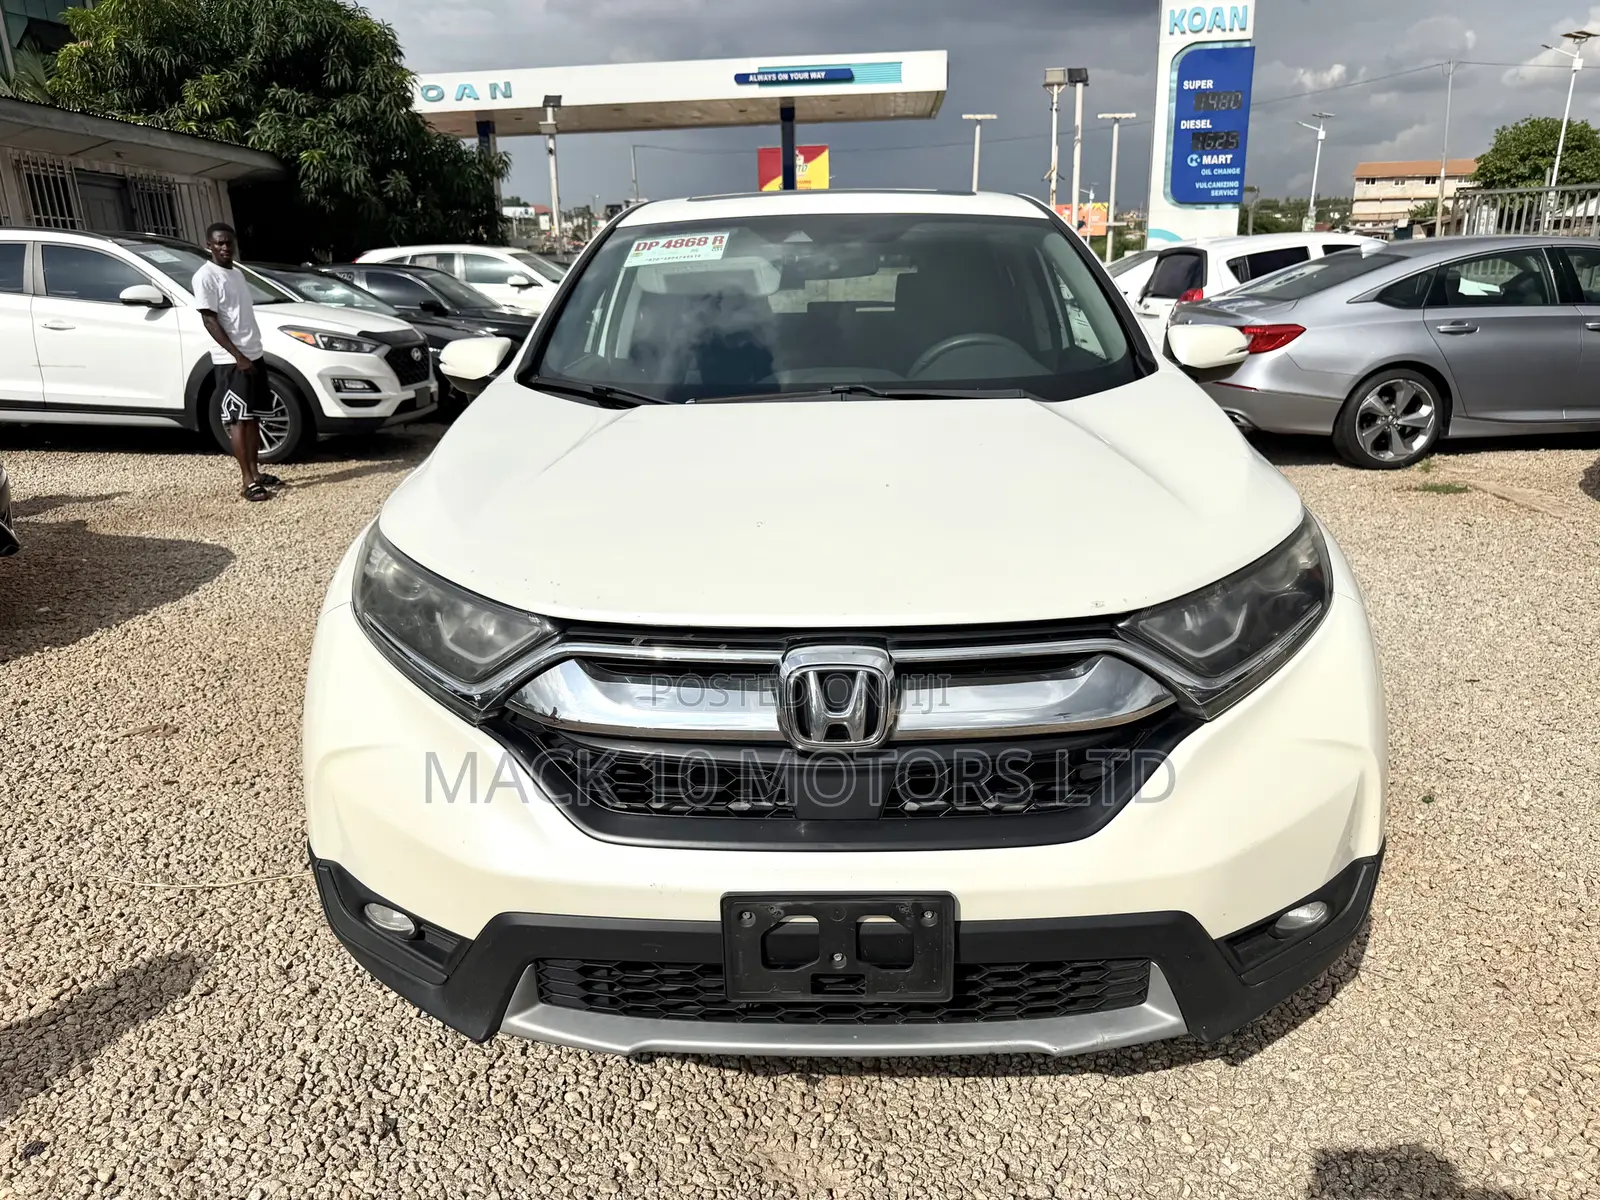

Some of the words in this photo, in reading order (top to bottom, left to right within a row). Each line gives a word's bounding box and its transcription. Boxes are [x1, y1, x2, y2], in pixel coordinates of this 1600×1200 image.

[1169, 5, 1248, 35] KOAN
[749, 73, 776, 82] ALWAYS
[778, 73, 789, 81] ON
[789, 72, 809, 80] YOUR
[810, 71, 826, 79] WAY
[1183, 79, 1213, 90] SUPER
[421, 81, 513, 102] OAN
[1180, 119, 1212, 129] DIESEL
[1202, 154, 1233, 165] MART
[1201, 168, 1212, 176] OIL
[1213, 167, 1241, 175] CHANGE
[1195, 181, 1239, 189] VULCANIZING
[634, 241, 659, 251] DP
[660, 236, 709, 249] 4868
[712, 235, 724, 245] R
